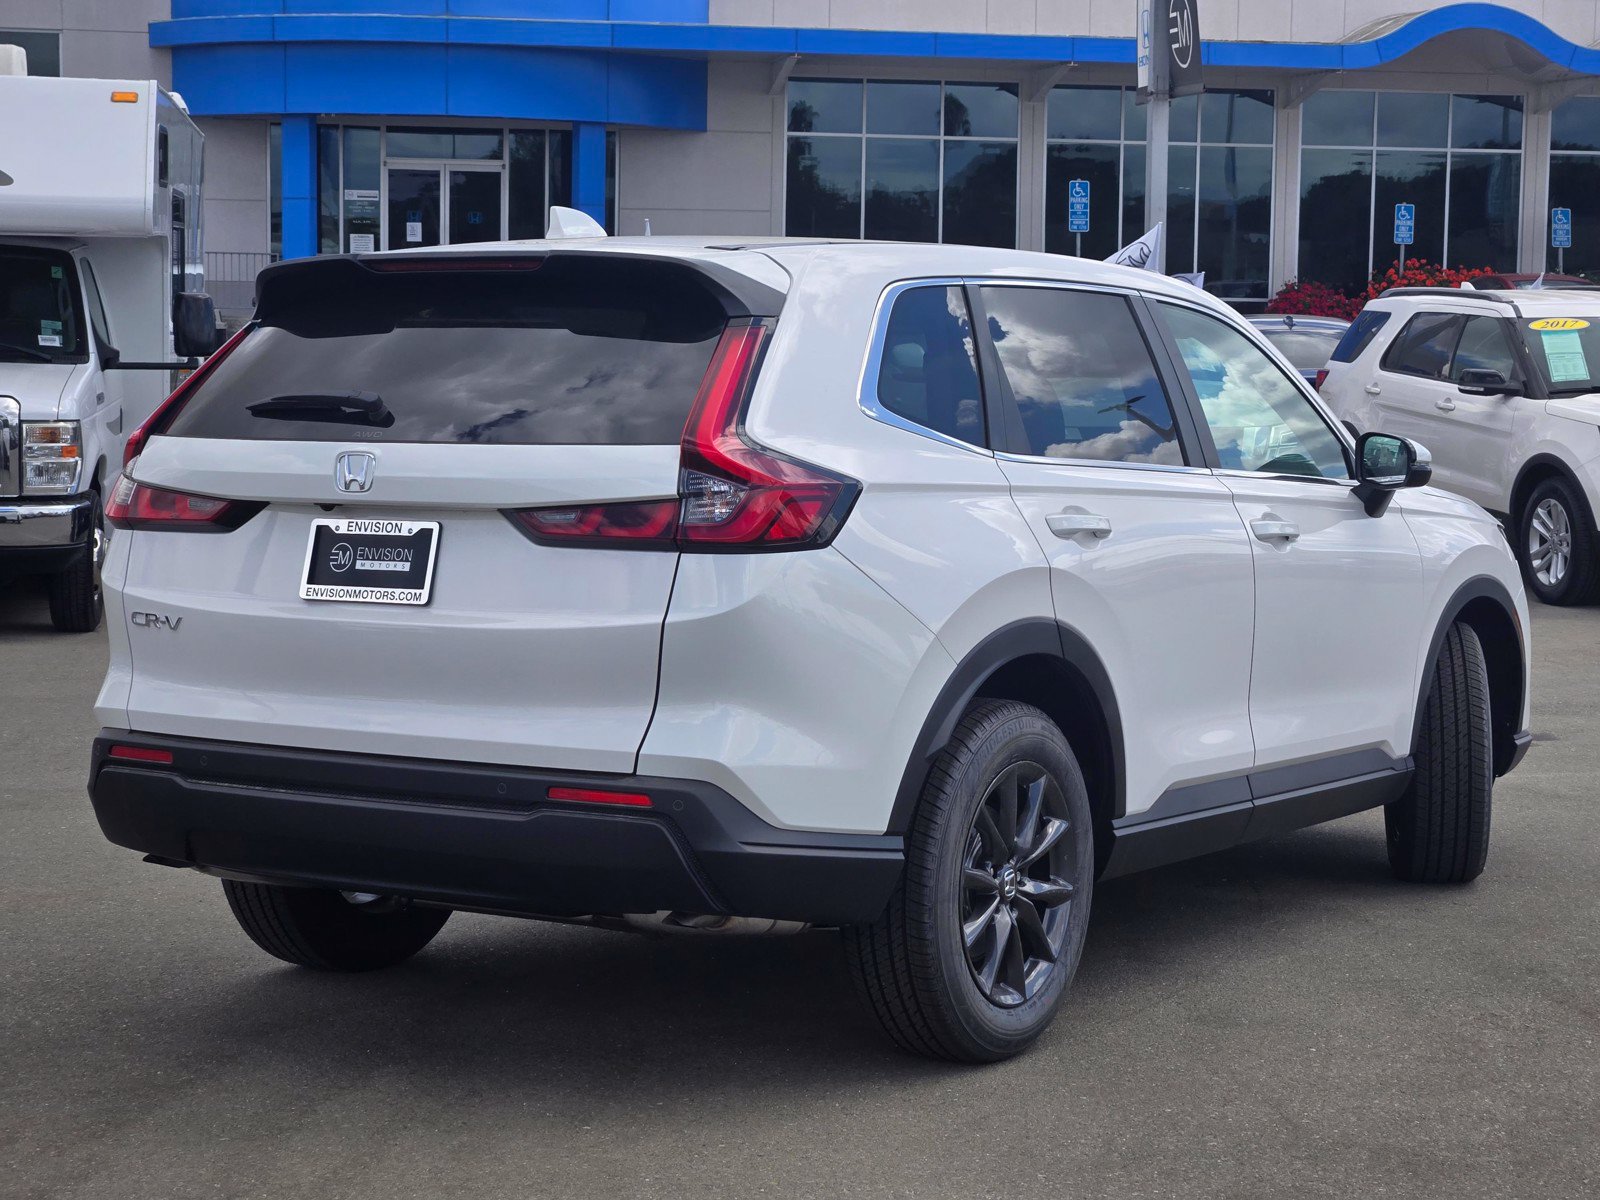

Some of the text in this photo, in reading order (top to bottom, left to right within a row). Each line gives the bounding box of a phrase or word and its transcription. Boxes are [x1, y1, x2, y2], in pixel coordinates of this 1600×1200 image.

[1540, 320, 1579, 329] 2017
[346, 521, 403, 533] ENVISION
[356, 546, 413, 561] ENVISION
[360, 562, 407, 570] MOTORS
[306, 587, 422, 601] ENVISIONMOTORS.COM
[131, 611, 183, 631] CR-V
